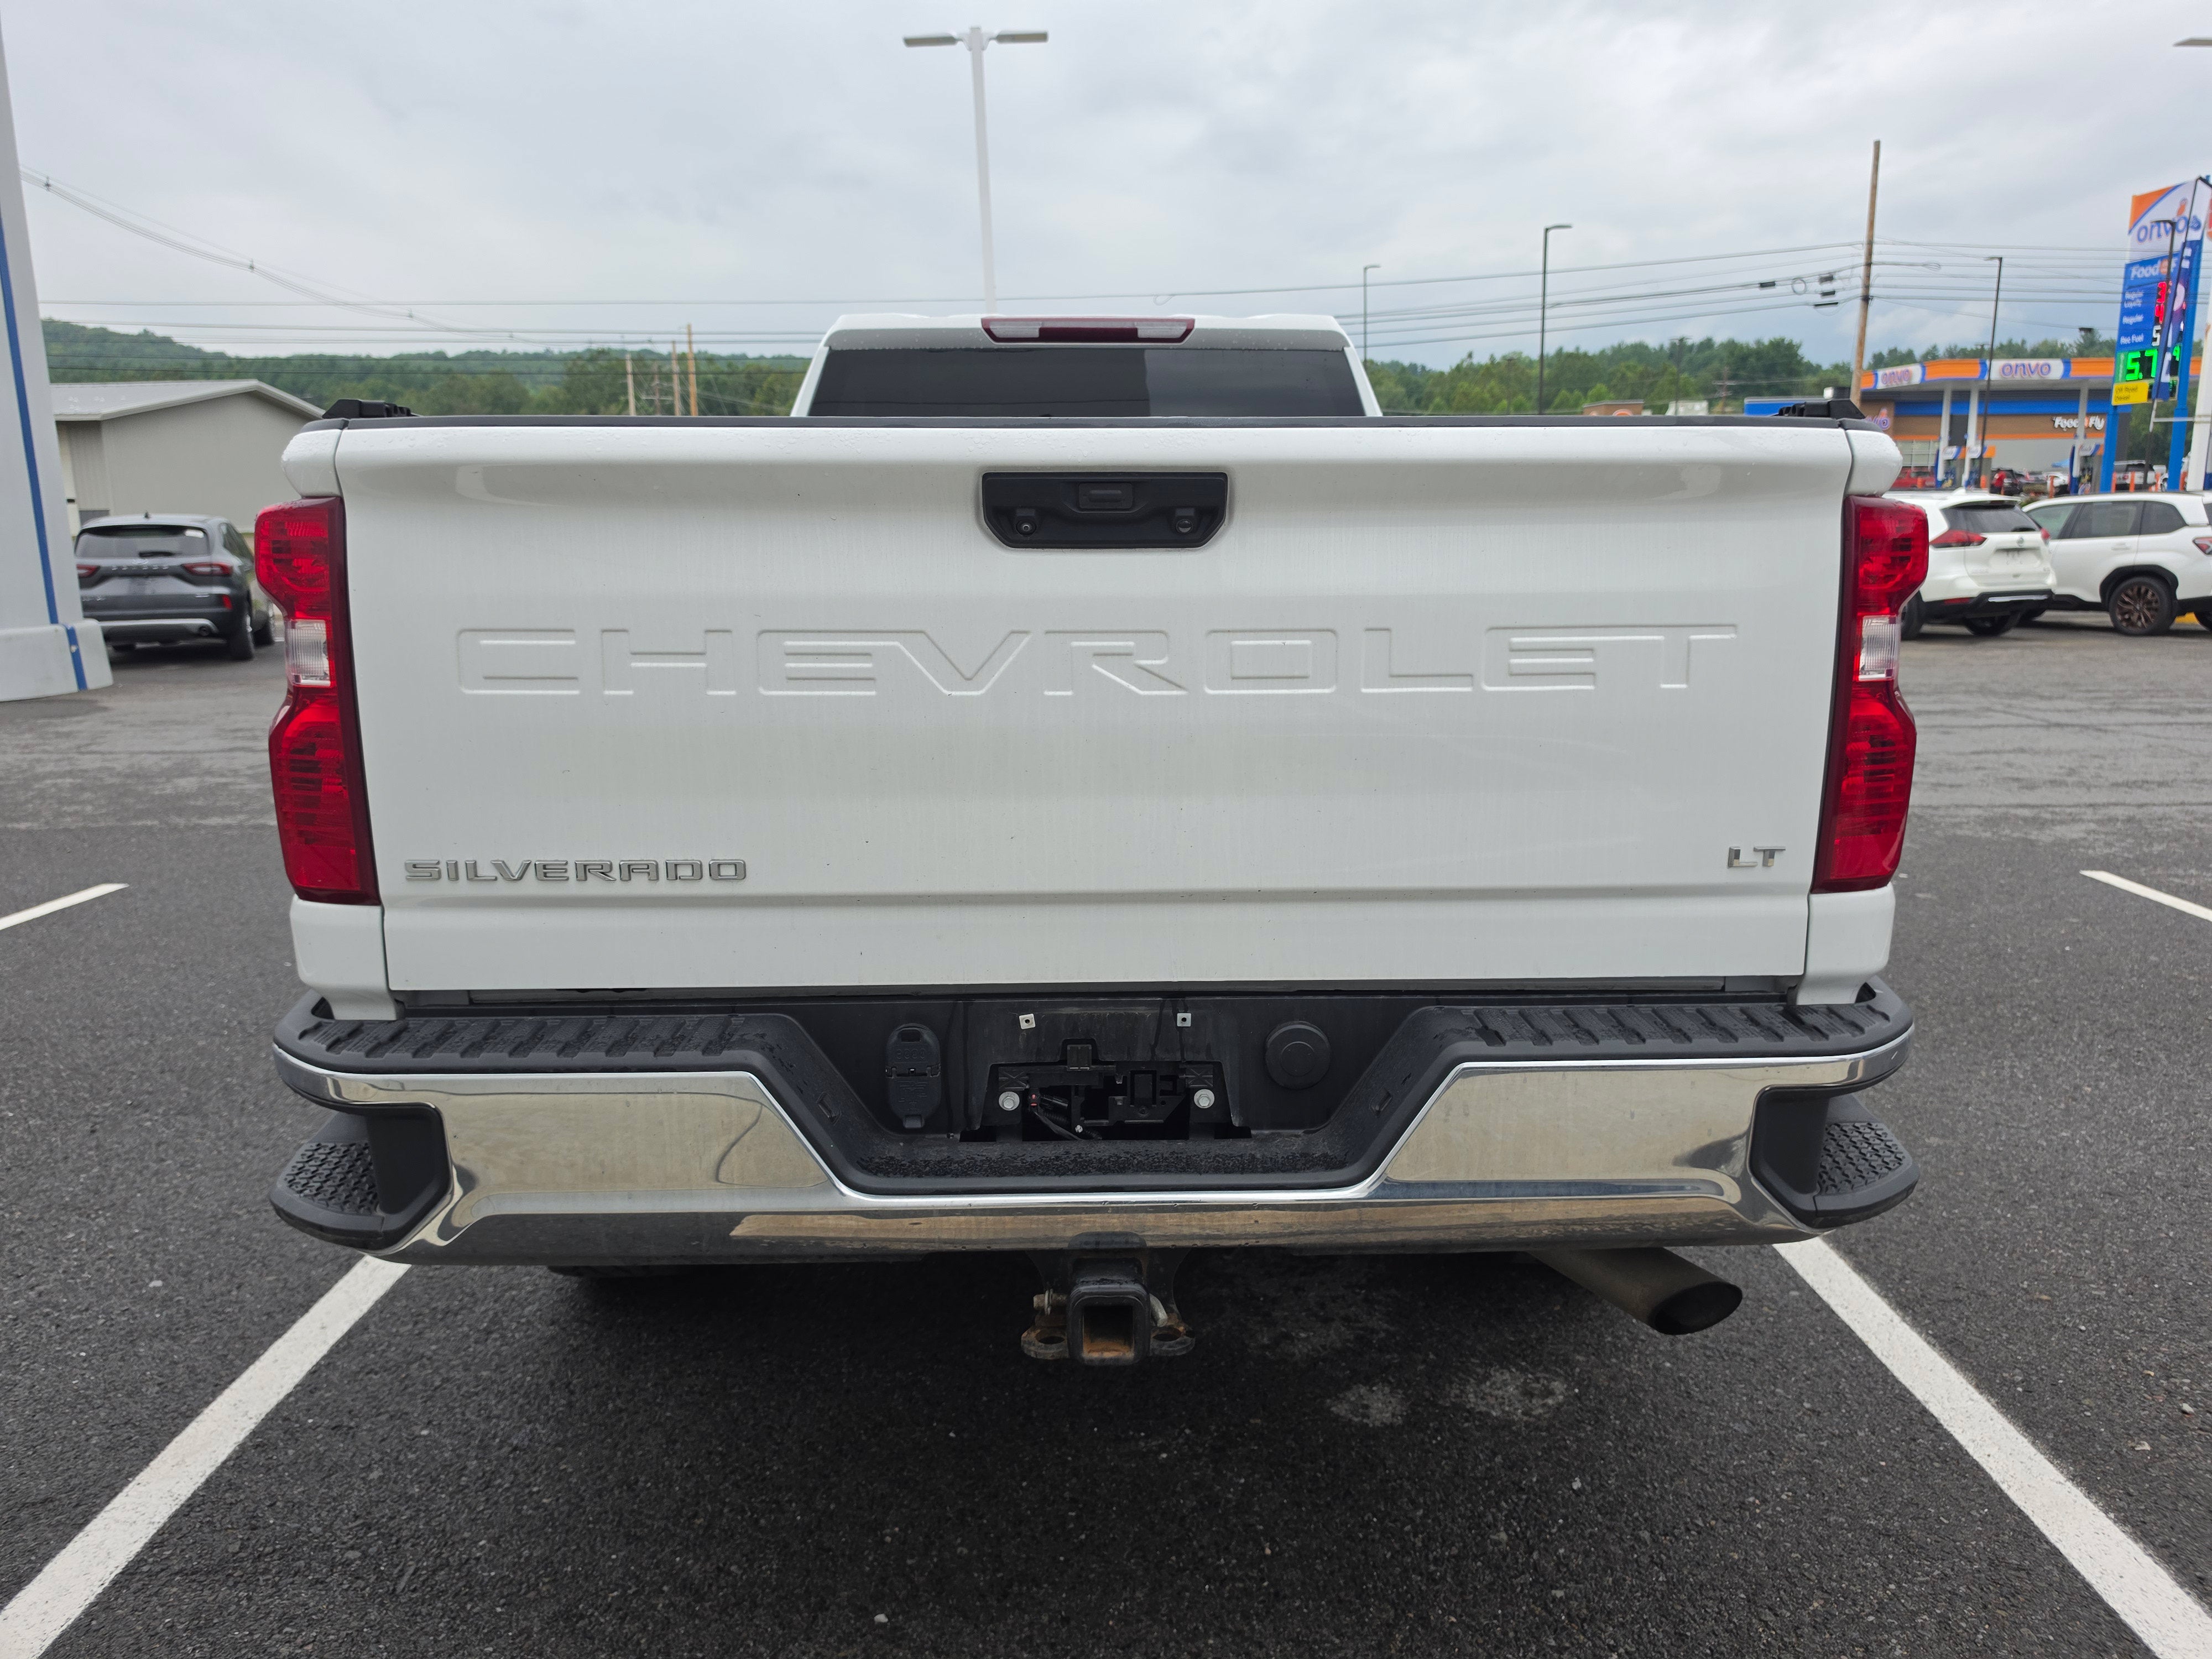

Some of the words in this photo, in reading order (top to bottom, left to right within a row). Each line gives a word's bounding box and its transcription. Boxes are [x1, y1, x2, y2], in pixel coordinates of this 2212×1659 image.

[1881, 368, 1911, 385] onvo
[2001, 362, 2051, 377] onvo
[456, 624, 1738, 698] CHEVROLET
[1727, 846, 1786, 869] LT
[404, 859, 747, 881] SILVERADO
